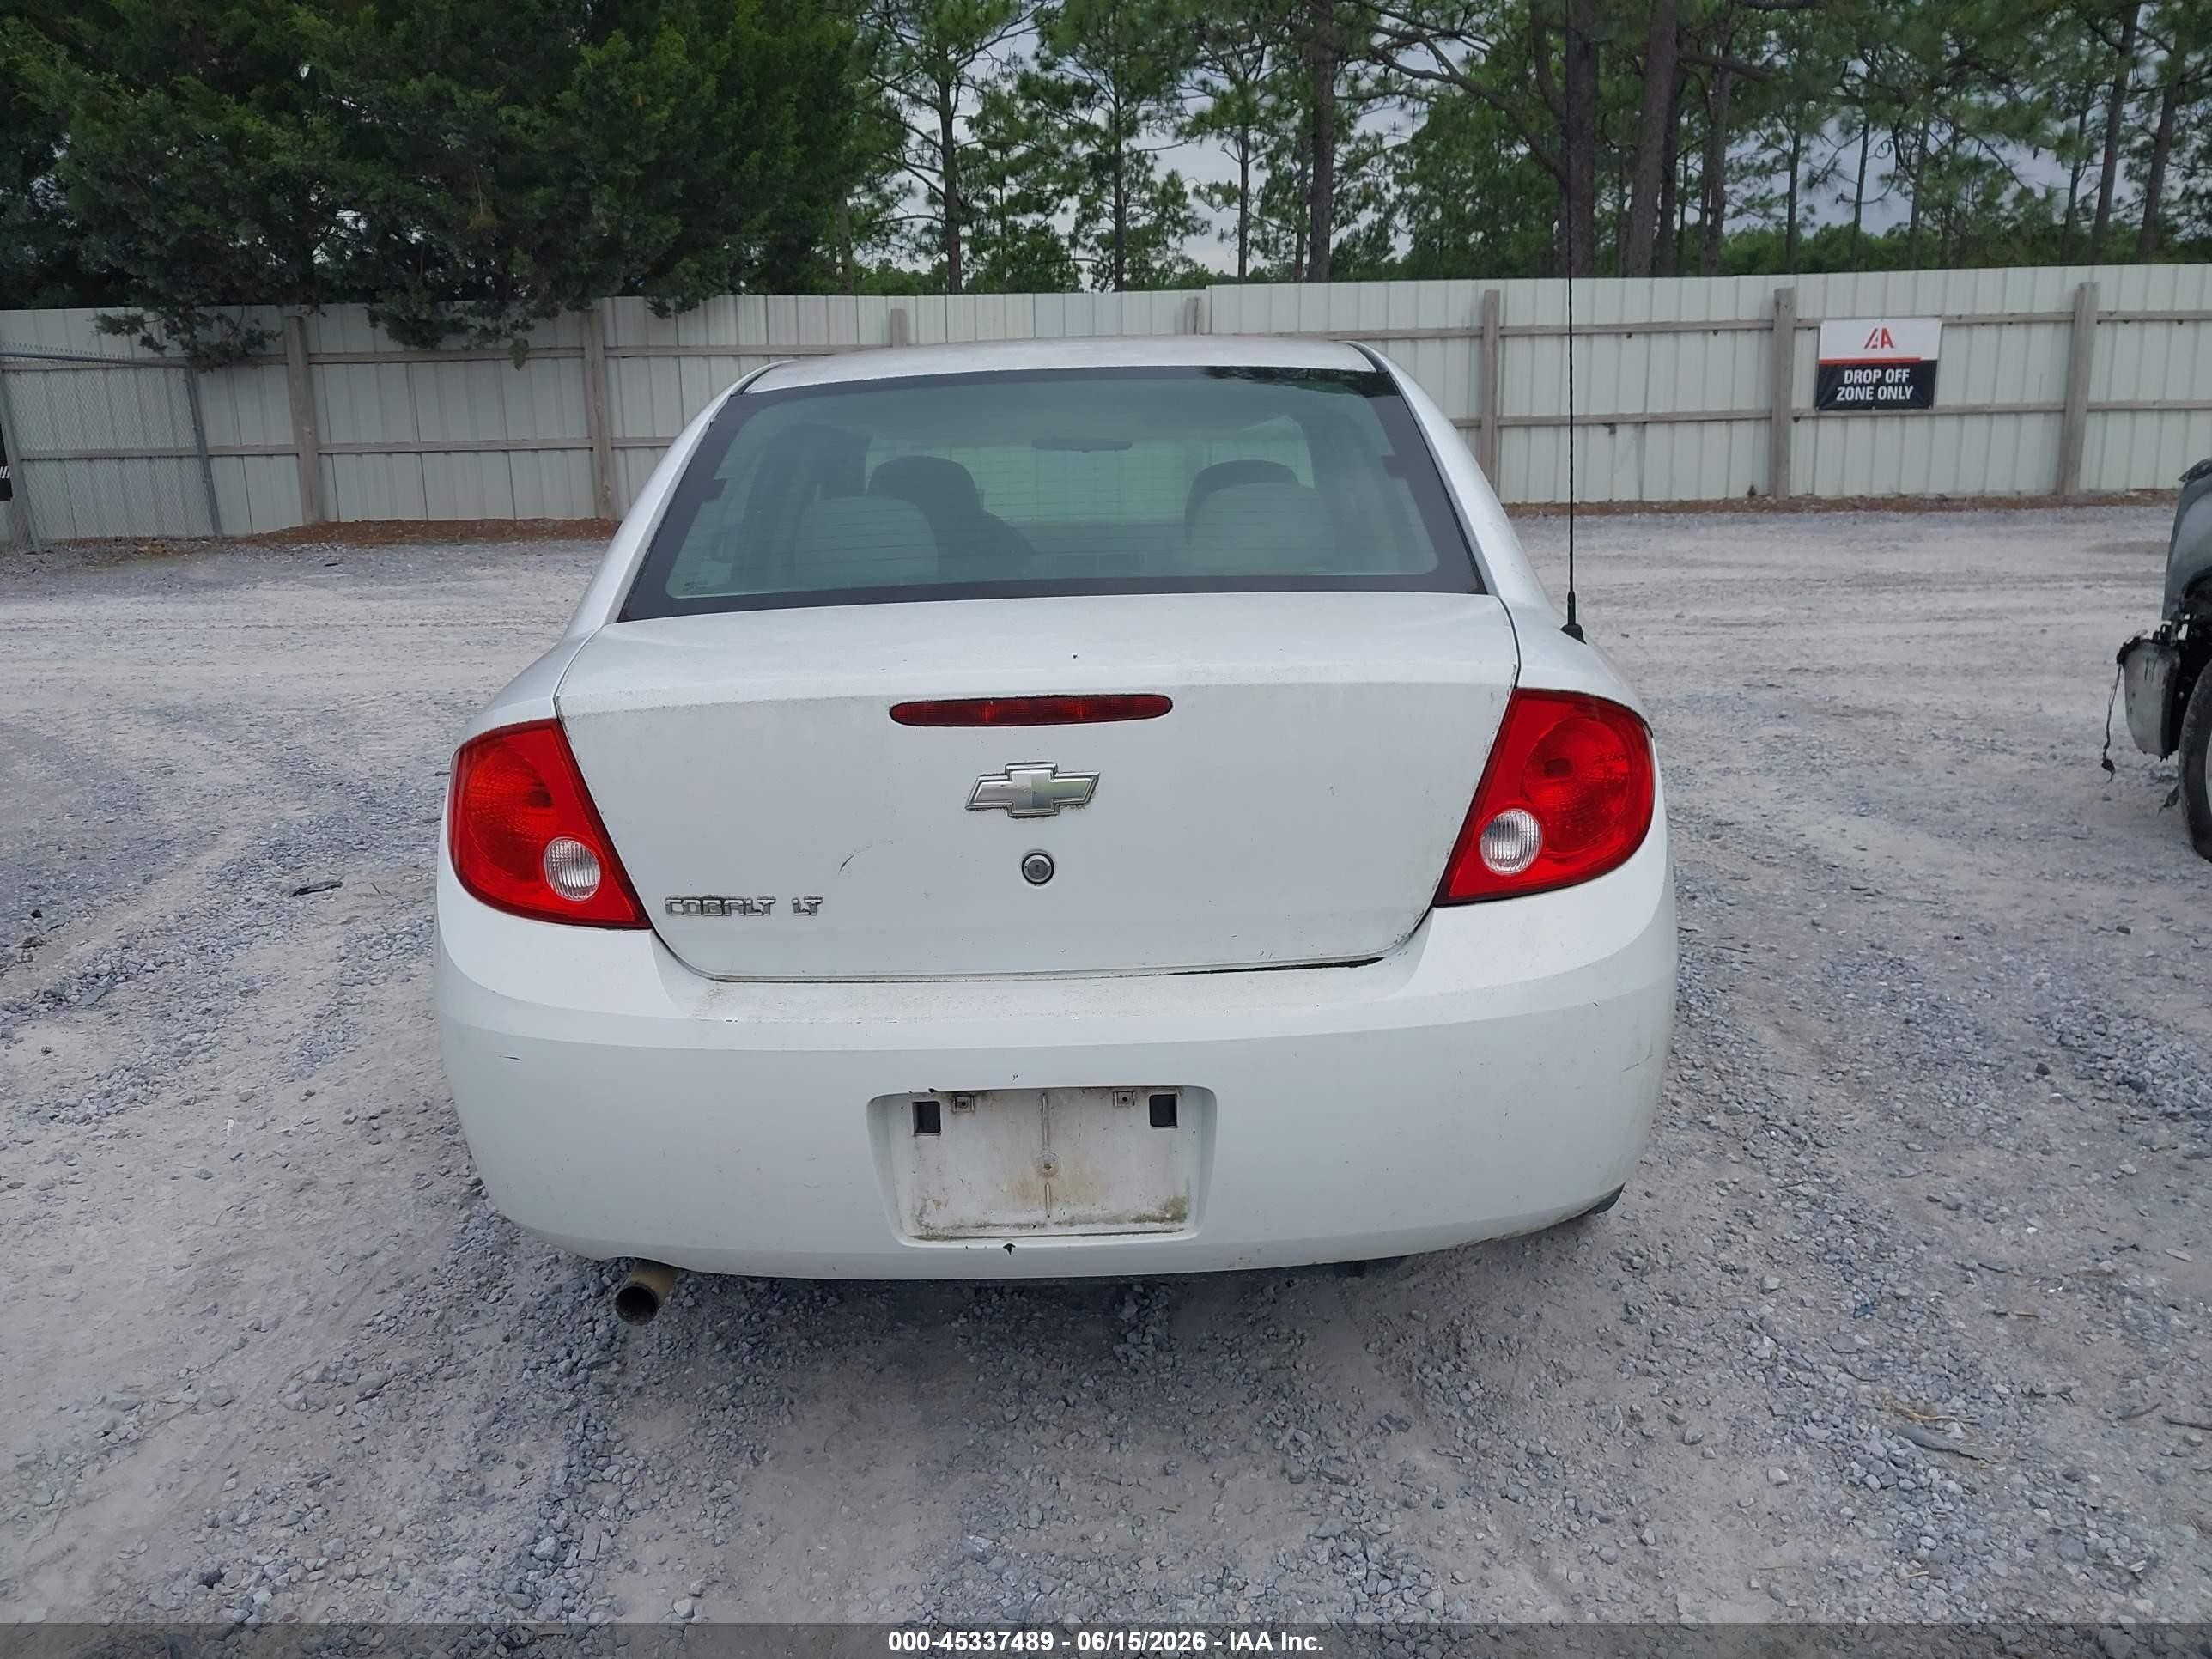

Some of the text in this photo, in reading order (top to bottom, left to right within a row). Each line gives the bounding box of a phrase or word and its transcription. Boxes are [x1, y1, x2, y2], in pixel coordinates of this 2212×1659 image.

[1844, 368, 1910, 384] DROP OFF
[1836, 386, 1914, 401] ZONE ONLY
[665, 896, 823, 916] COBALT LT
